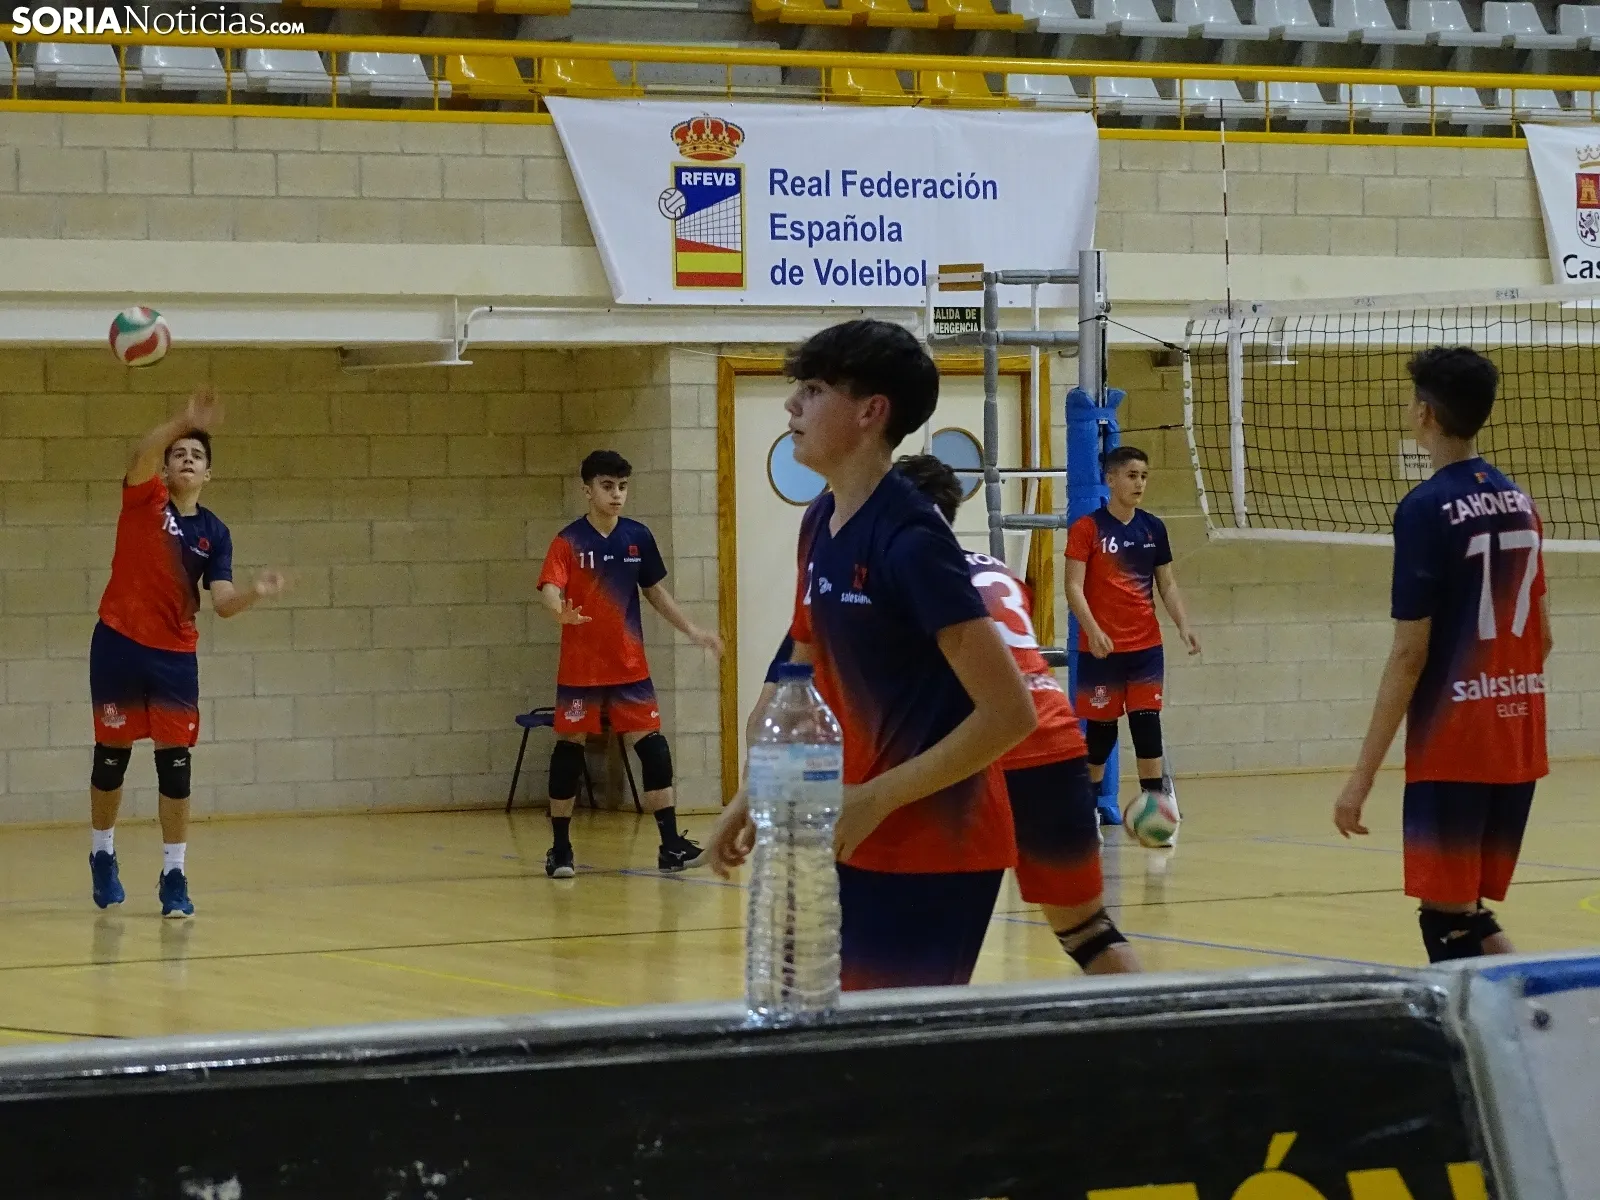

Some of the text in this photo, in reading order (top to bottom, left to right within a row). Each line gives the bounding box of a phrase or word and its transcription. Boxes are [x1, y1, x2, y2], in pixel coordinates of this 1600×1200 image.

[681, 171, 736, 187] RFEVB
[769, 168, 998, 200] Real Federación
[769, 213, 903, 247] Española
[770, 258, 927, 287] de Voleibol
[933, 308, 977, 320] ALIDA DE
[934, 322, 979, 334] MERGENCIA
[1101, 536, 1119, 554] 16
[579, 551, 595, 569] 11
[1465, 529, 1540, 641] 17
